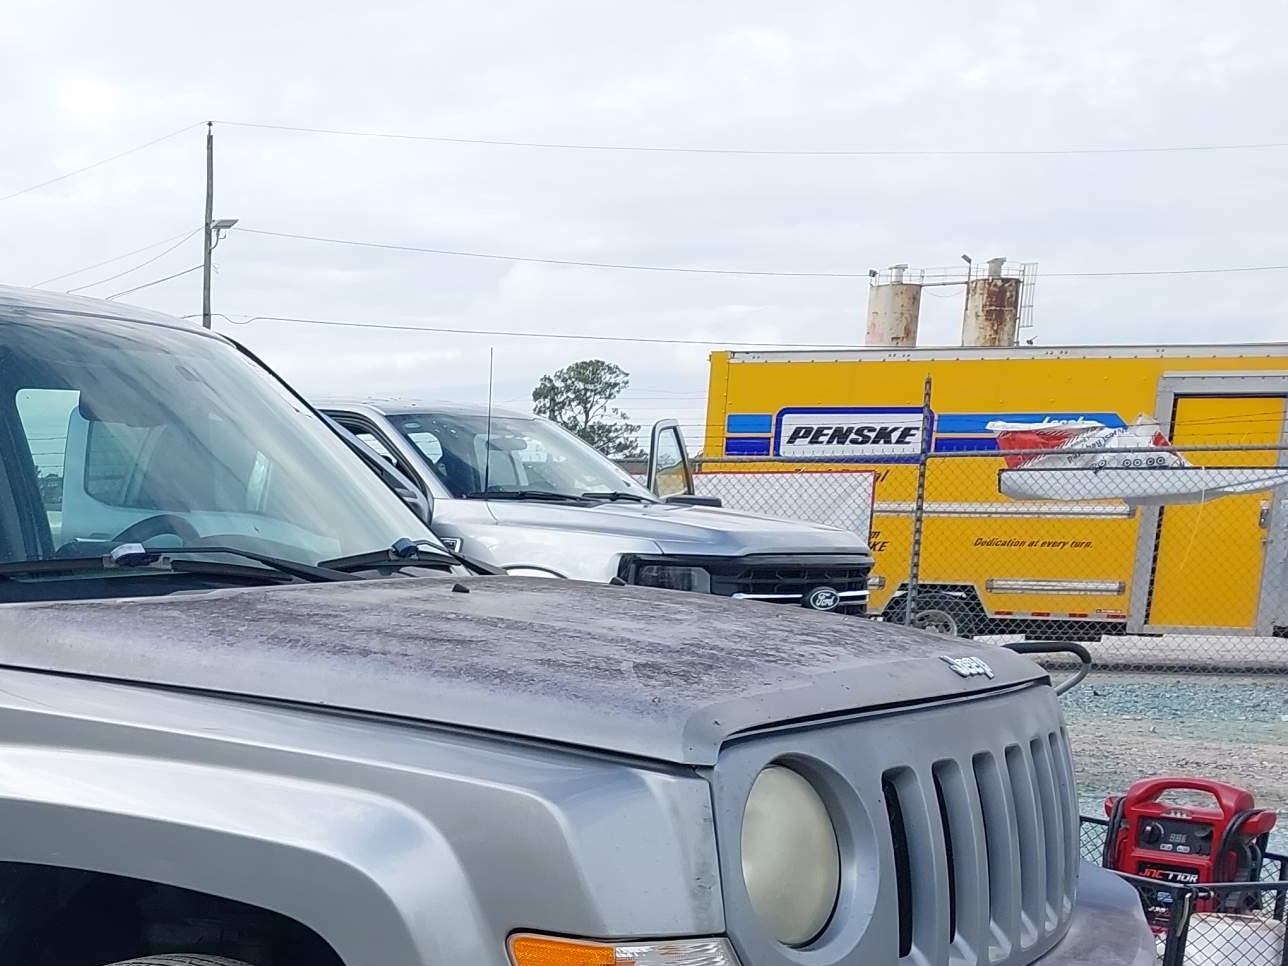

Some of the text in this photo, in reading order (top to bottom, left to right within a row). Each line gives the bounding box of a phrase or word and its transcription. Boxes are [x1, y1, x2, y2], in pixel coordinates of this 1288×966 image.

[786, 425, 921, 446] PENSKE
[973, 537, 1026, 548] Dedication
[1027, 540, 1039, 548] at
[1040, 540, 1069, 550] every
[815, 592, 835, 609] Ford
[938, 655, 995, 680] Jeep
